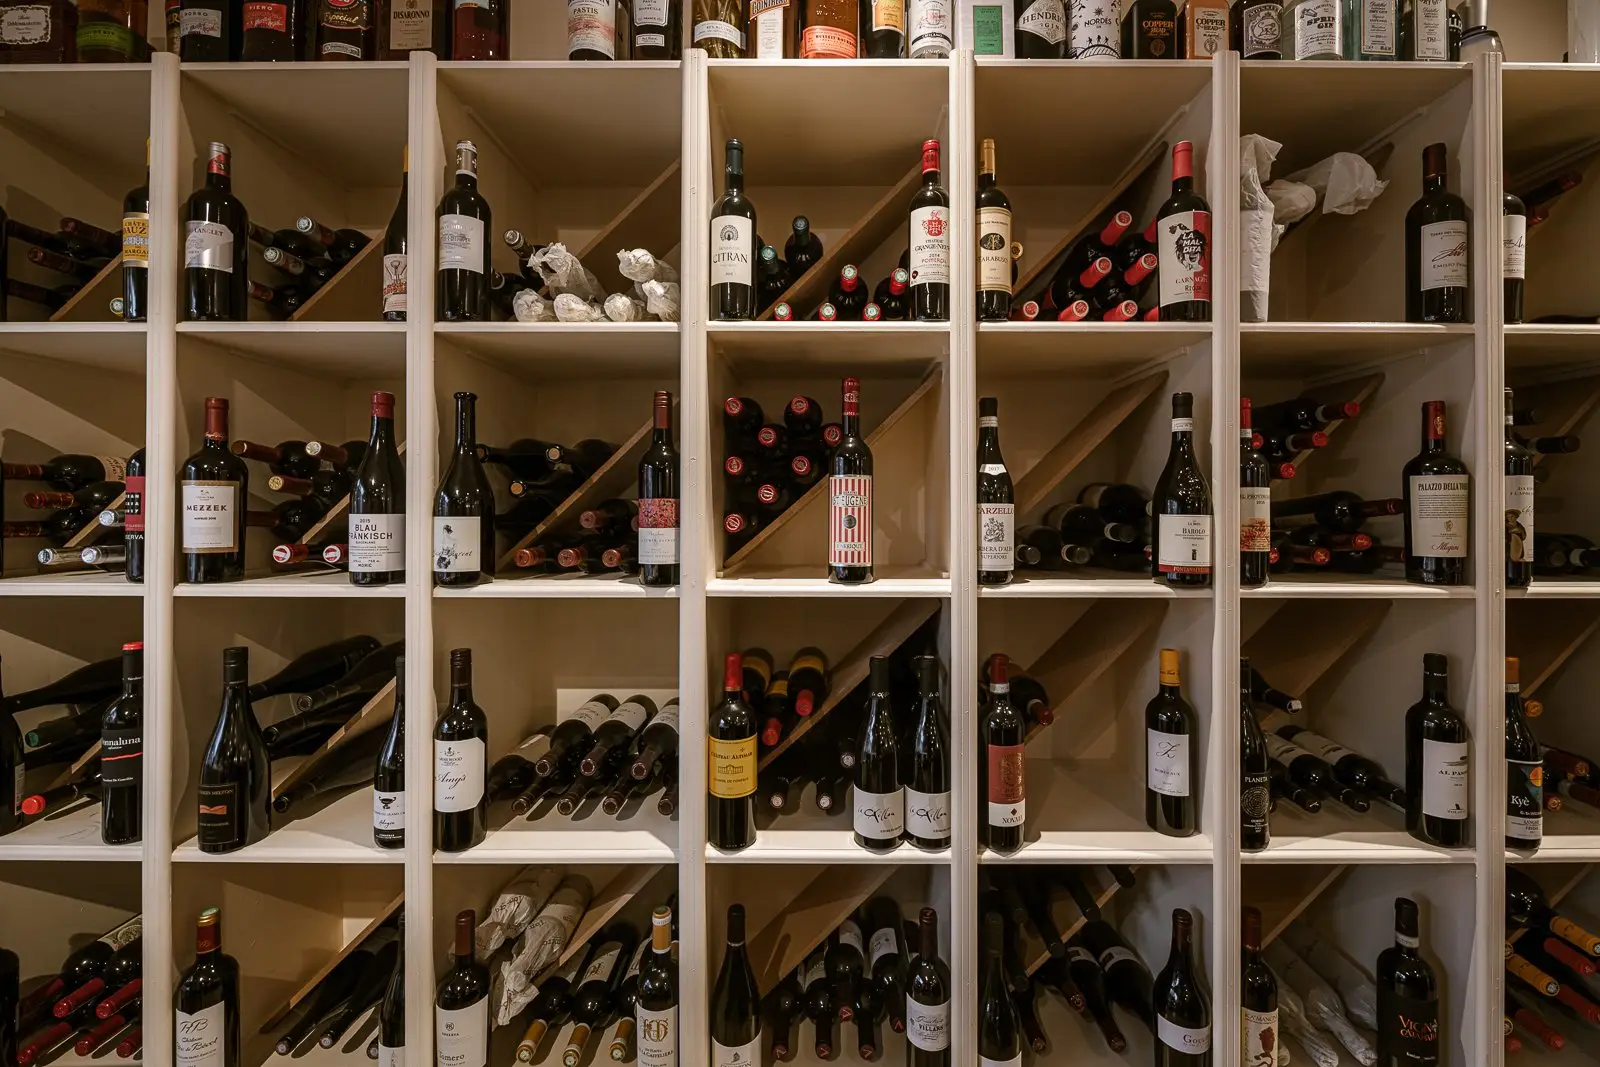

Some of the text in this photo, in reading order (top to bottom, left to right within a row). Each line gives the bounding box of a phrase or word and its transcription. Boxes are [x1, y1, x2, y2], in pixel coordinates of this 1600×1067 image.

[573, 7, 599, 15] PASTIS
[752, 0, 789, 15] COINTR
[393, 10, 430, 20] DISARONNO
[1196, 18, 1225, 26] COPPER
[1306, 16, 1339, 26] SPRIN
[713, 252, 748, 264] CITRAN
[1418, 482, 1442, 491] PALAZZO
[103, 736, 141, 747] nnaluna
[1511, 795, 1530, 807] Kyè
